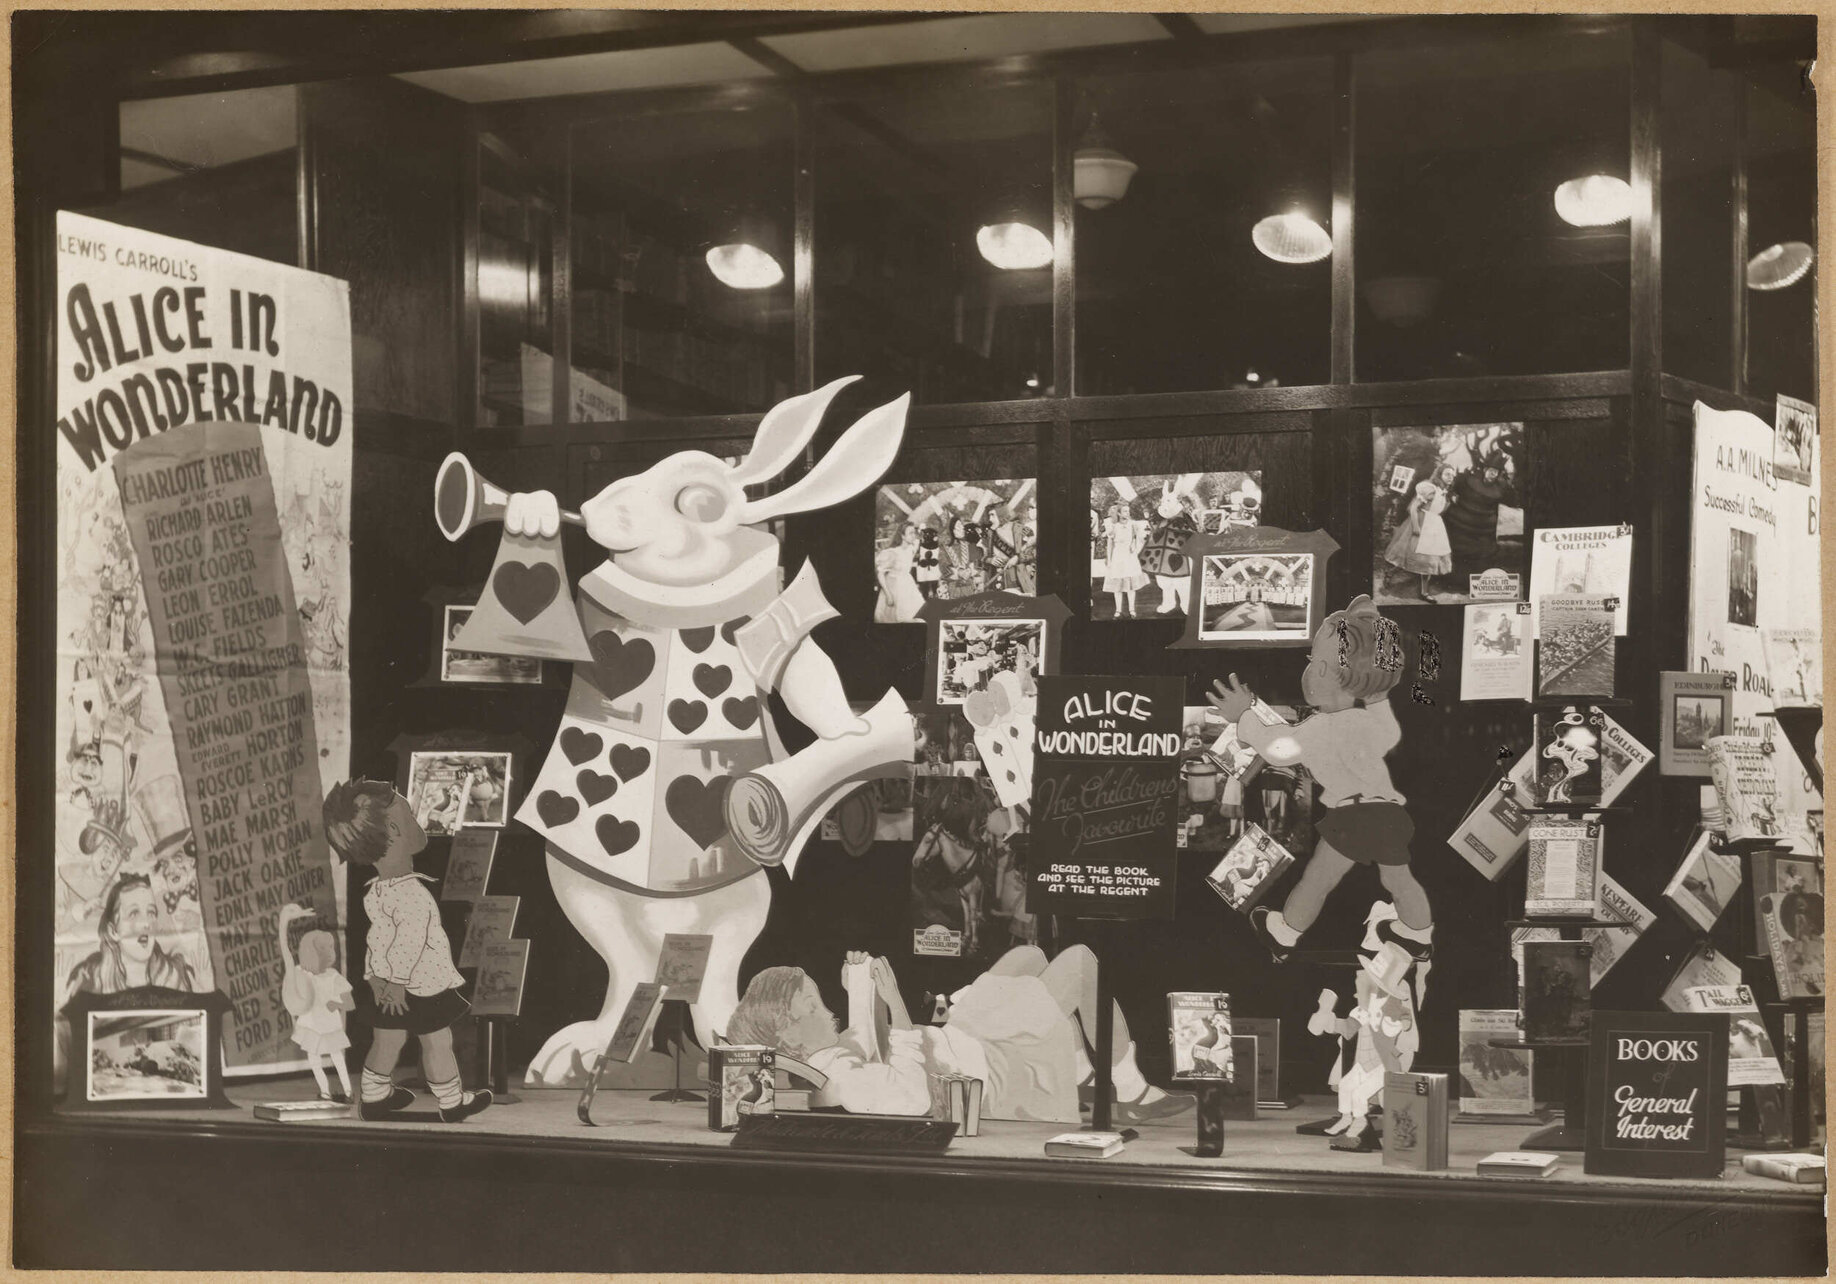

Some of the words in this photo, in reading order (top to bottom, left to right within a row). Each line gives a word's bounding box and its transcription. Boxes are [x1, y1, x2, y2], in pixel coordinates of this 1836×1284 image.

[58, 234, 106, 262] LEWIS
[115, 247, 198, 282] CARROLL'S
[66, 282, 213, 382] ALICE
[57, 361, 343, 473] WONDERLAND
[122, 459, 209, 505] CHARLOTTE
[210, 446, 263, 485] HENRY
[146, 507, 201, 542] RICHARD
[206, 495, 252, 526] ARLEN
[1703, 485, 1745, 515] Successful
[1748, 497, 1777, 537] Comedy
[152, 535, 203, 568] ROSCO
[212, 524, 248, 553] ATES
[1555, 541, 1607, 551] COLLEGES
[158, 563, 193, 593] GARY
[200, 550, 257, 582] COOPER
[163, 588, 201, 619] LEON
[208, 575, 259, 606] ERROL
[168, 611, 217, 645] LOUISE
[222, 594, 285, 630] FAZENDA
[213, 626, 267, 659] FIELDS
[177, 664, 223, 698] SKEETS
[228, 643, 300, 681] GALLAGHER
[184, 692, 219, 722] CARY
[226, 675, 279, 708] GRANT
[1063, 689, 1153, 724] ALICE
[186, 709, 254, 750] RAYMOND
[258, 691, 307, 727] HATTON
[192, 743, 230, 764] EDWARD
[245, 720, 304, 756] HORTON
[1099, 718, 1117, 729] IN
[1037, 730, 1182, 757] WONDERLAND
[1607, 727, 1648, 764] COLLEGES
[196, 761, 256, 801] ROSCOE
[260, 744, 305, 779] KARNS
[200, 792, 240, 826] BABY
[1037, 774, 1077, 822] The
[204, 821, 238, 852] MAE
[245, 799, 298, 837] MARSH
[208, 842, 254, 878] POLLY
[261, 819, 313, 859] MORAN
[1050, 863, 1081, 874] READ
[1085, 865, 1110, 875] THE
[1114, 866, 1149, 876] BOOK
[213, 869, 254, 902] JACK
[260, 850, 305, 884] OAKIE
[215, 901, 254, 927] EDNA
[255, 883, 284, 912] MAY
[287, 865, 326, 900] OLIVER
[1037, 872, 1062, 883] AND
[1065, 874, 1085, 884] SEE
[1089, 875, 1114, 885] THE
[1116, 876, 1161, 887] PICTURE
[1048, 884, 1067, 893] AT
[1070, 884, 1096, 894] THE
[1100, 885, 1149, 896] REGENT
[1601, 883, 1645, 924] KESPEARE
[220, 922, 250, 953] MAY
[224, 937, 281, 978] CHARLIE
[229, 967, 270, 1001] ALISON
[232, 997, 261, 1028] NED
[235, 1018, 271, 1052] FORD
[1616, 1038, 1699, 1062] BOOKS
[1614, 1085, 1699, 1118] General
[1616, 1115, 1694, 1141] Interest
